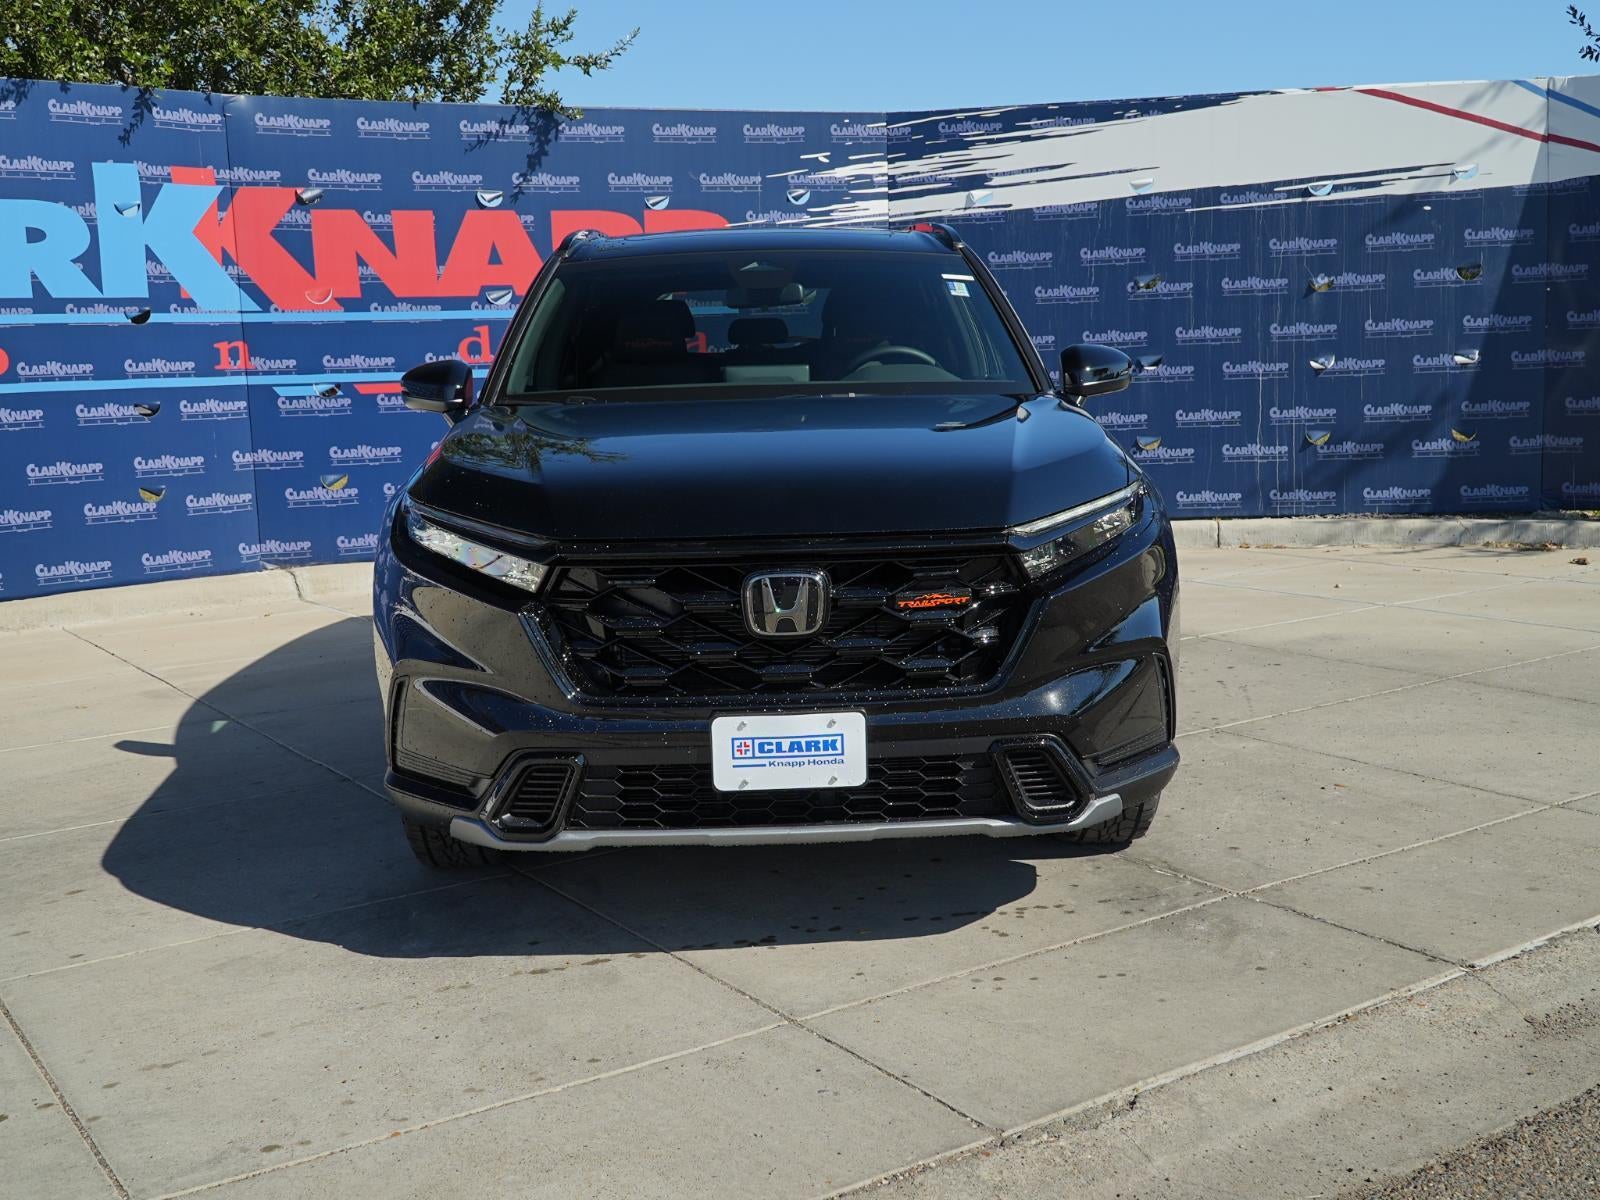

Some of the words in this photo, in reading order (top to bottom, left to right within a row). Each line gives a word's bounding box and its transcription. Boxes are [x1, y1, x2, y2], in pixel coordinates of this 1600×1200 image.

[898, 596, 970, 608] TRAILSPORT
[757, 738, 839, 754] CLARK
[768, 759, 805, 768] Knapp
[807, 757, 844, 766] Honda
